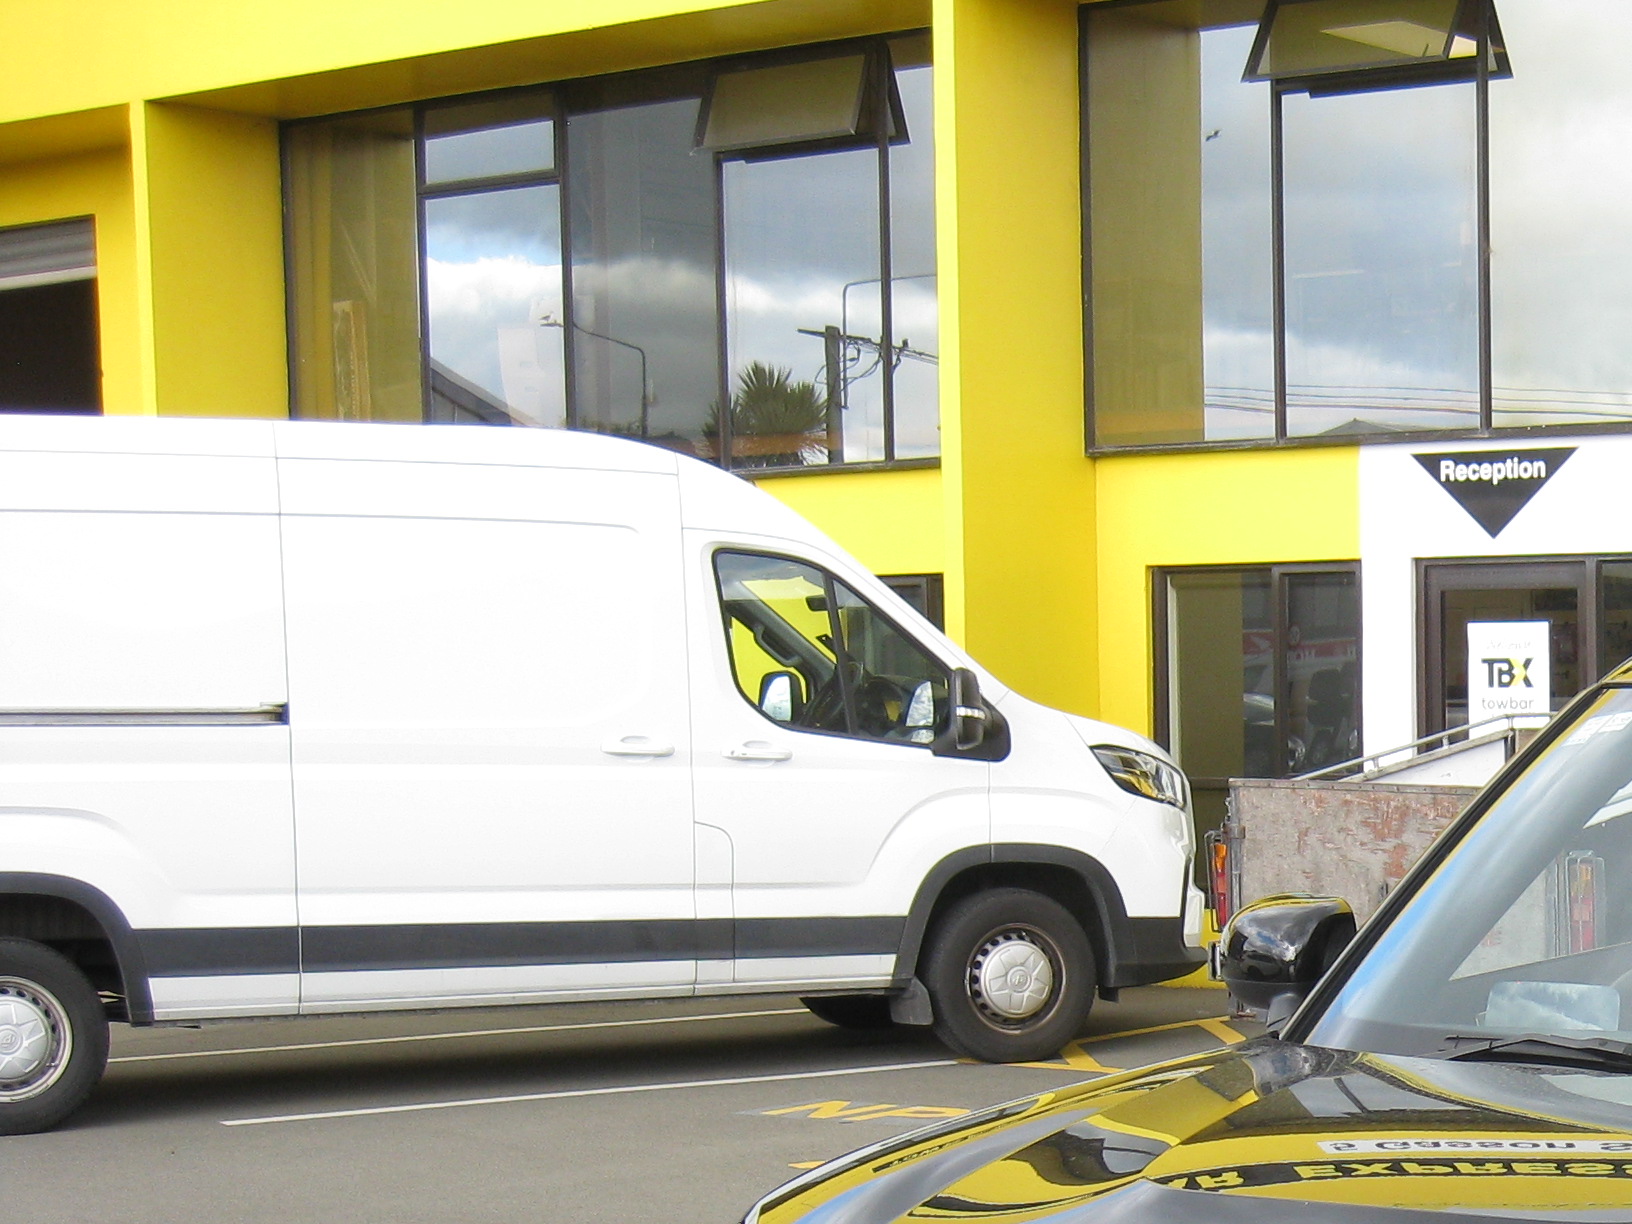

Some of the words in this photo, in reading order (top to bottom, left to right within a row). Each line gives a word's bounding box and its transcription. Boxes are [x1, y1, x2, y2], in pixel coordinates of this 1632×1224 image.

[1440, 457, 1546, 485] Reception
[1481, 658, 1534, 688] TBX
[1482, 697, 1534, 710] towbar
